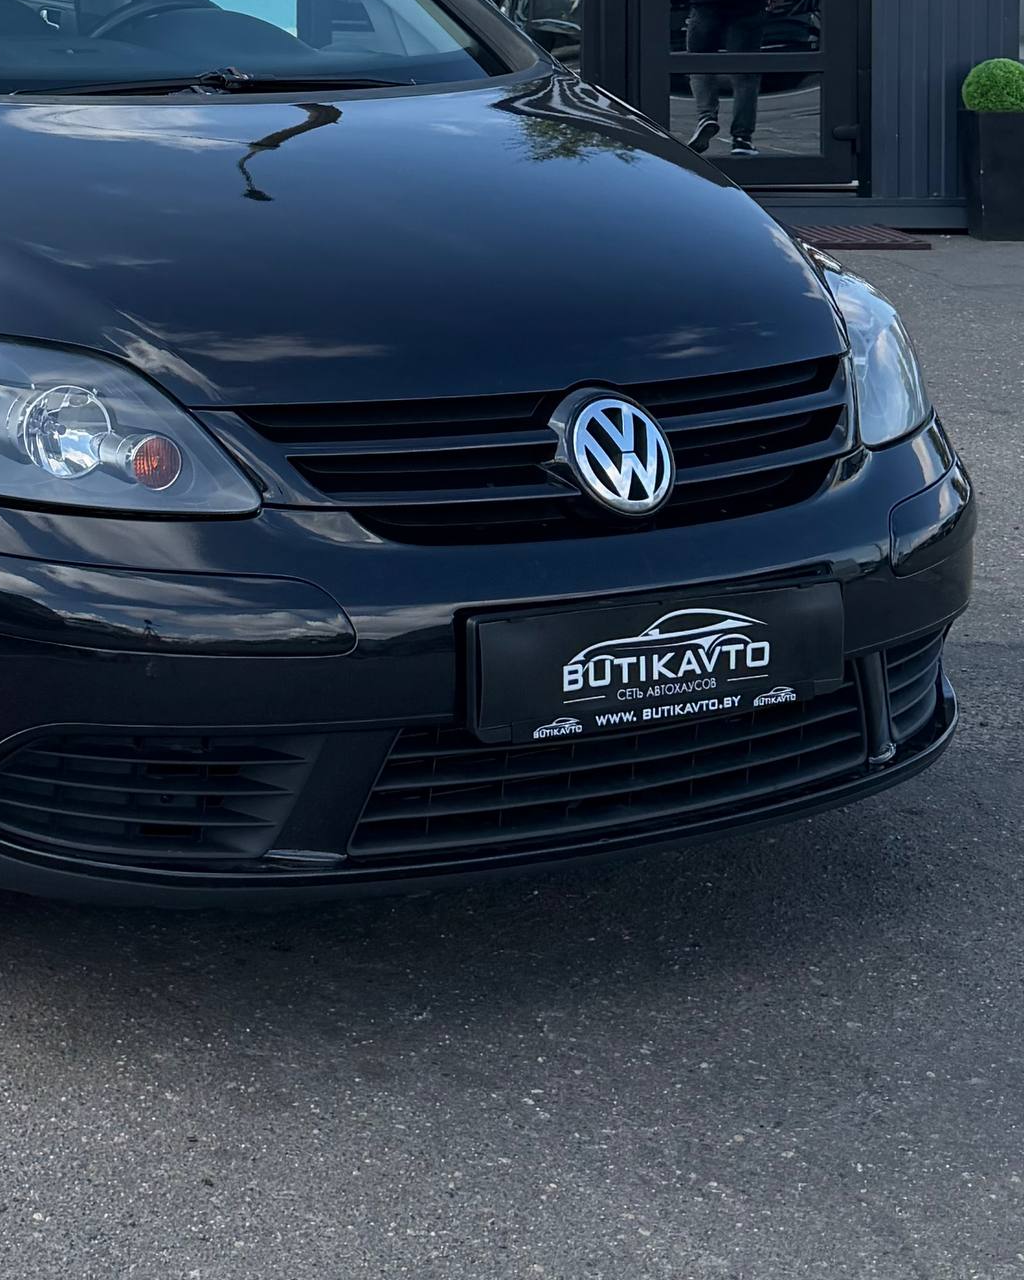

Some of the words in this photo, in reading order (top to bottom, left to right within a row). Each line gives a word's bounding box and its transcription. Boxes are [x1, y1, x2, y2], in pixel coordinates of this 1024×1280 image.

[577, 401, 667, 508] VW
[563, 641, 770, 692] BUTIKAVTO
[617, 688, 644, 701] СЕТЬ
[646, 678, 717, 698] АВТОХАУСОВ
[753, 693, 797, 707] BUTIKAVTO
[595, 710, 637, 726] WWW.
[642, 695, 741, 720] BUTIKAVTO.BY
[533, 724, 583, 739] BUTIKAVTO
